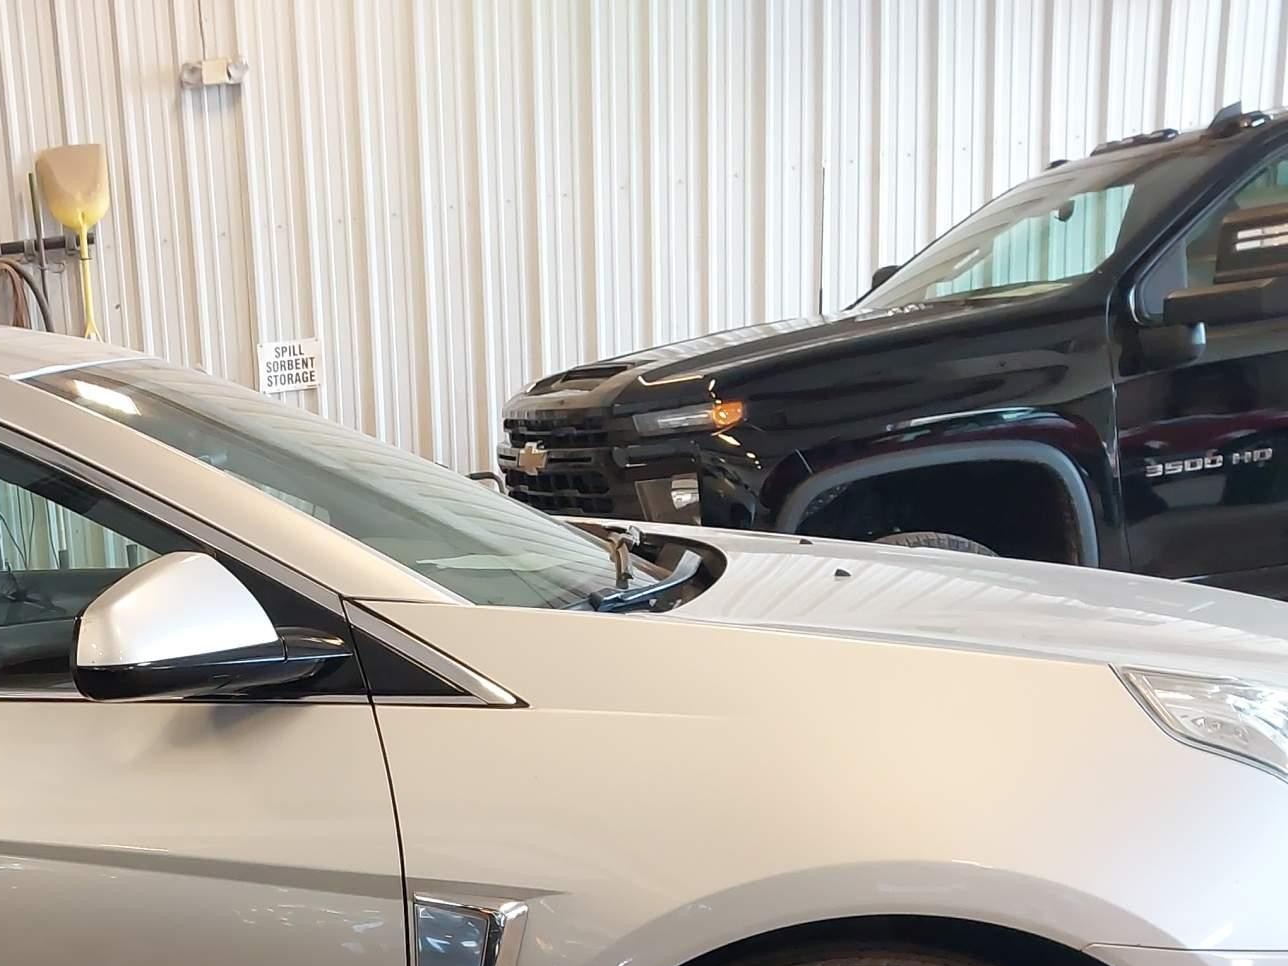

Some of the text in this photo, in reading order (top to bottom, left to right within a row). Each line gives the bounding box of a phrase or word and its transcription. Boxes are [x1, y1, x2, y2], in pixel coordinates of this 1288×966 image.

[274, 344, 305, 359] SPILL
[266, 357, 315, 373] SORBENT
[267, 371, 316, 388] STORAGE
[1145, 448, 1273, 477] 3500 HD
